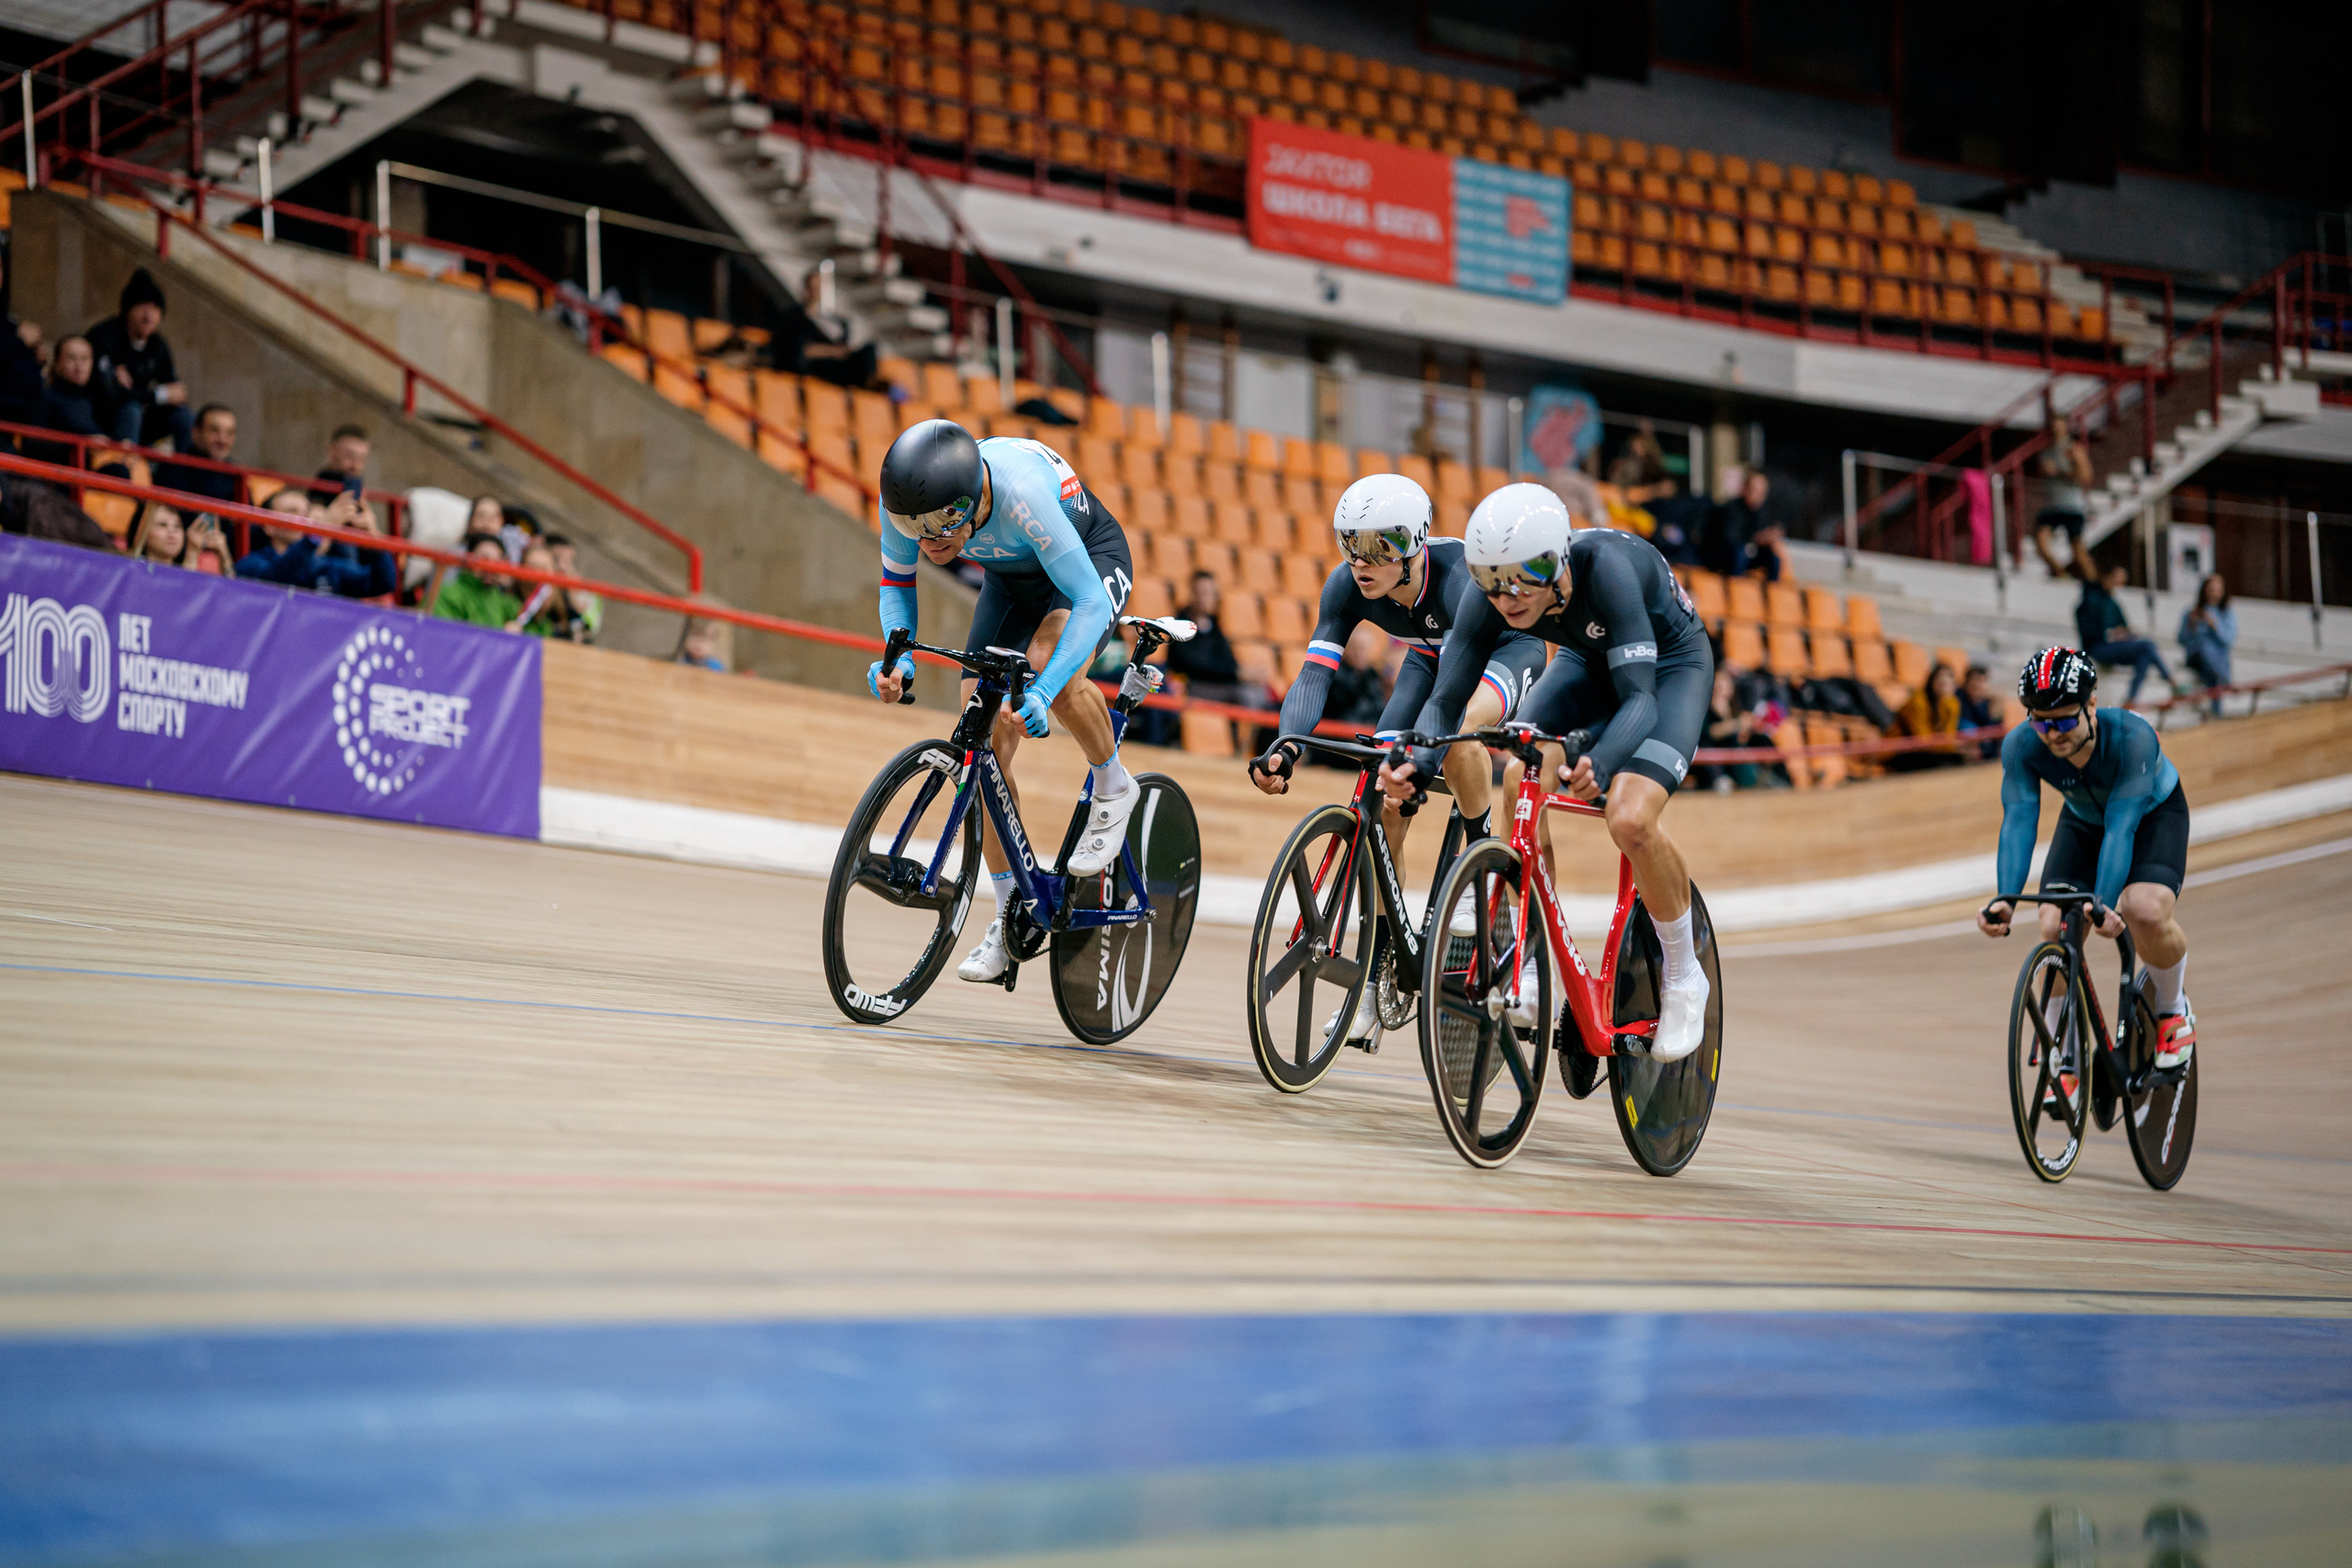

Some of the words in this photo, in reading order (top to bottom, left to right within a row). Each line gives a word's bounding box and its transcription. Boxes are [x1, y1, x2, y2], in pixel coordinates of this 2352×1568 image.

[1010, 500, 1053, 552] RCA
[1413, 506, 1433, 548] KA
[119, 612, 152, 654] ЛЕТ
[0, 592, 111, 724] 100
[119, 651, 249, 710] МОСКОВСКОМУ
[117, 691, 187, 739] СПОРТУ
[368, 682, 471, 724] SPORT
[917, 748, 963, 786] FFW
[985, 752, 1035, 872] PINARELLO
[1374, 823, 1407, 925] ARGON
[1403, 922, 1419, 956] 18
[844, 983, 908, 1017] FFWD
